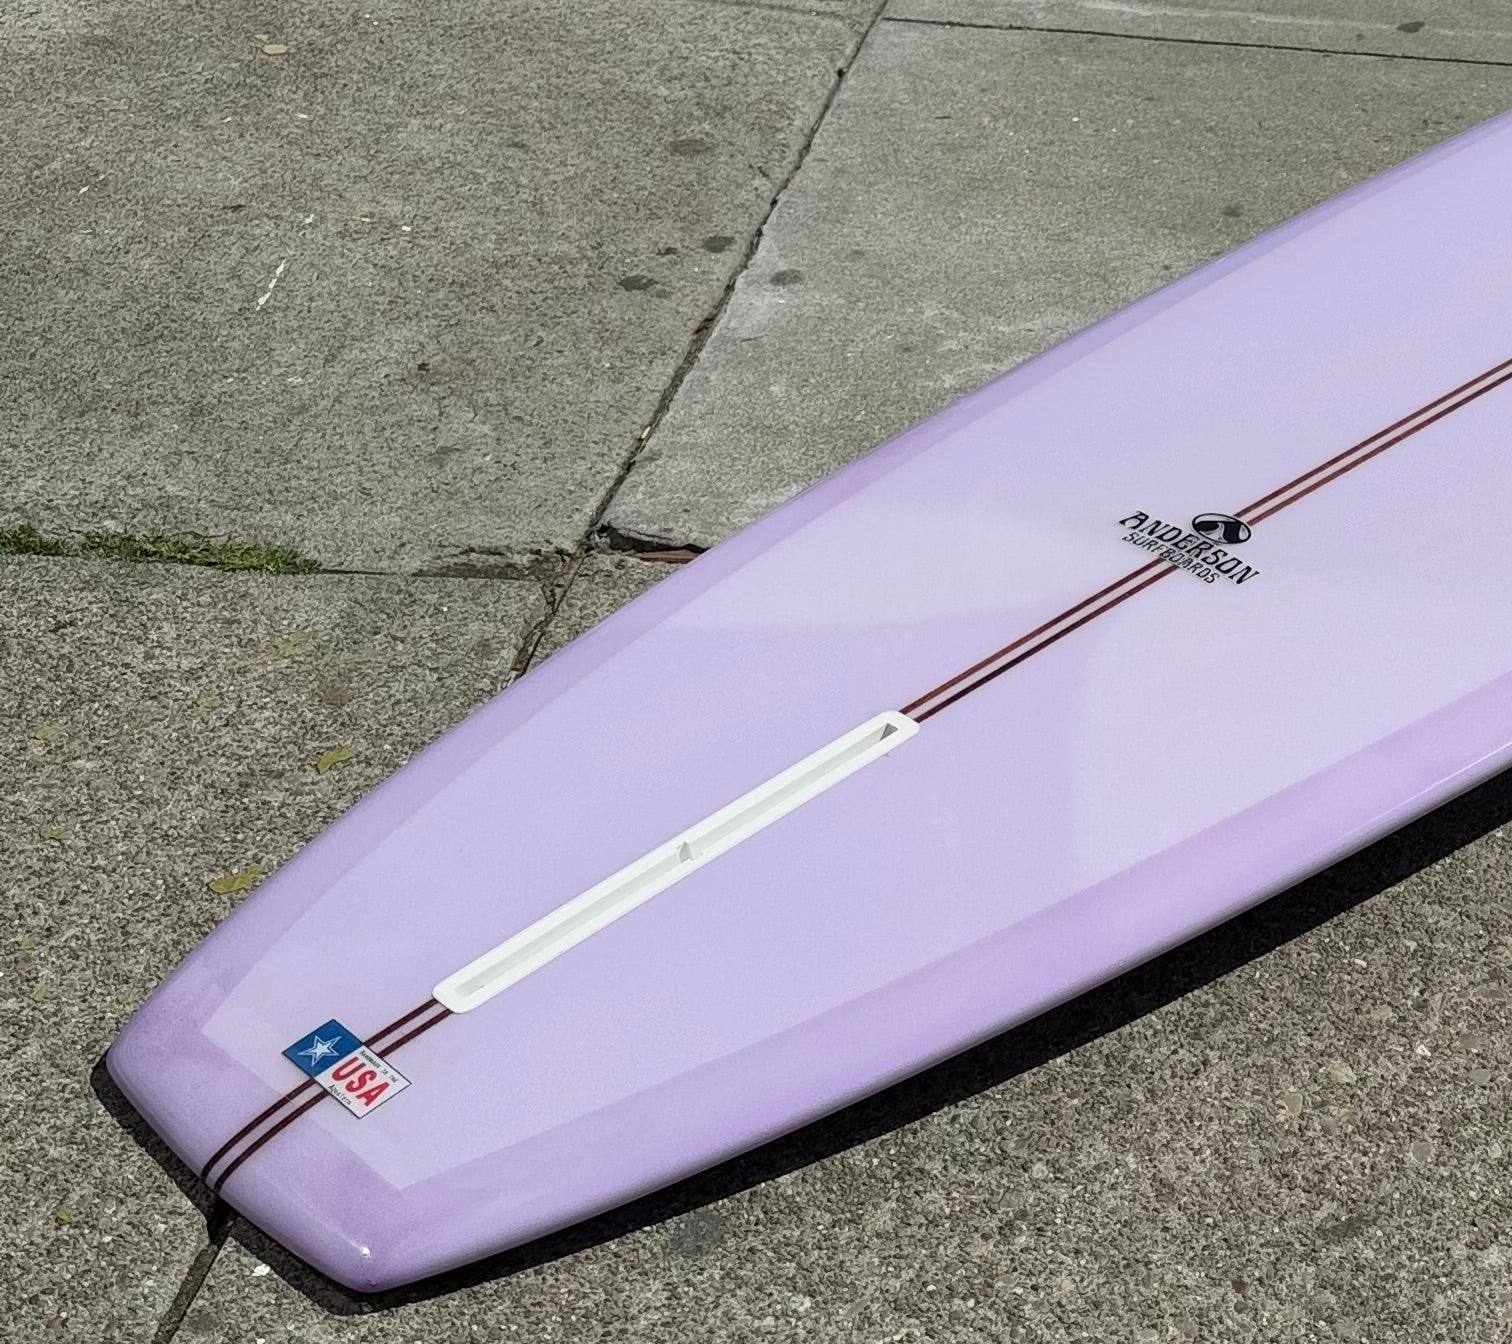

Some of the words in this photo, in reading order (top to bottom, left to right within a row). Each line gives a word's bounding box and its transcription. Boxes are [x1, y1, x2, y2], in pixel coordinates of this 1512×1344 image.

[1118, 510, 1260, 585] ANDERSON
[1122, 531, 1221, 585] SURFBOARDS
[332, 1056, 390, 1107] USA
